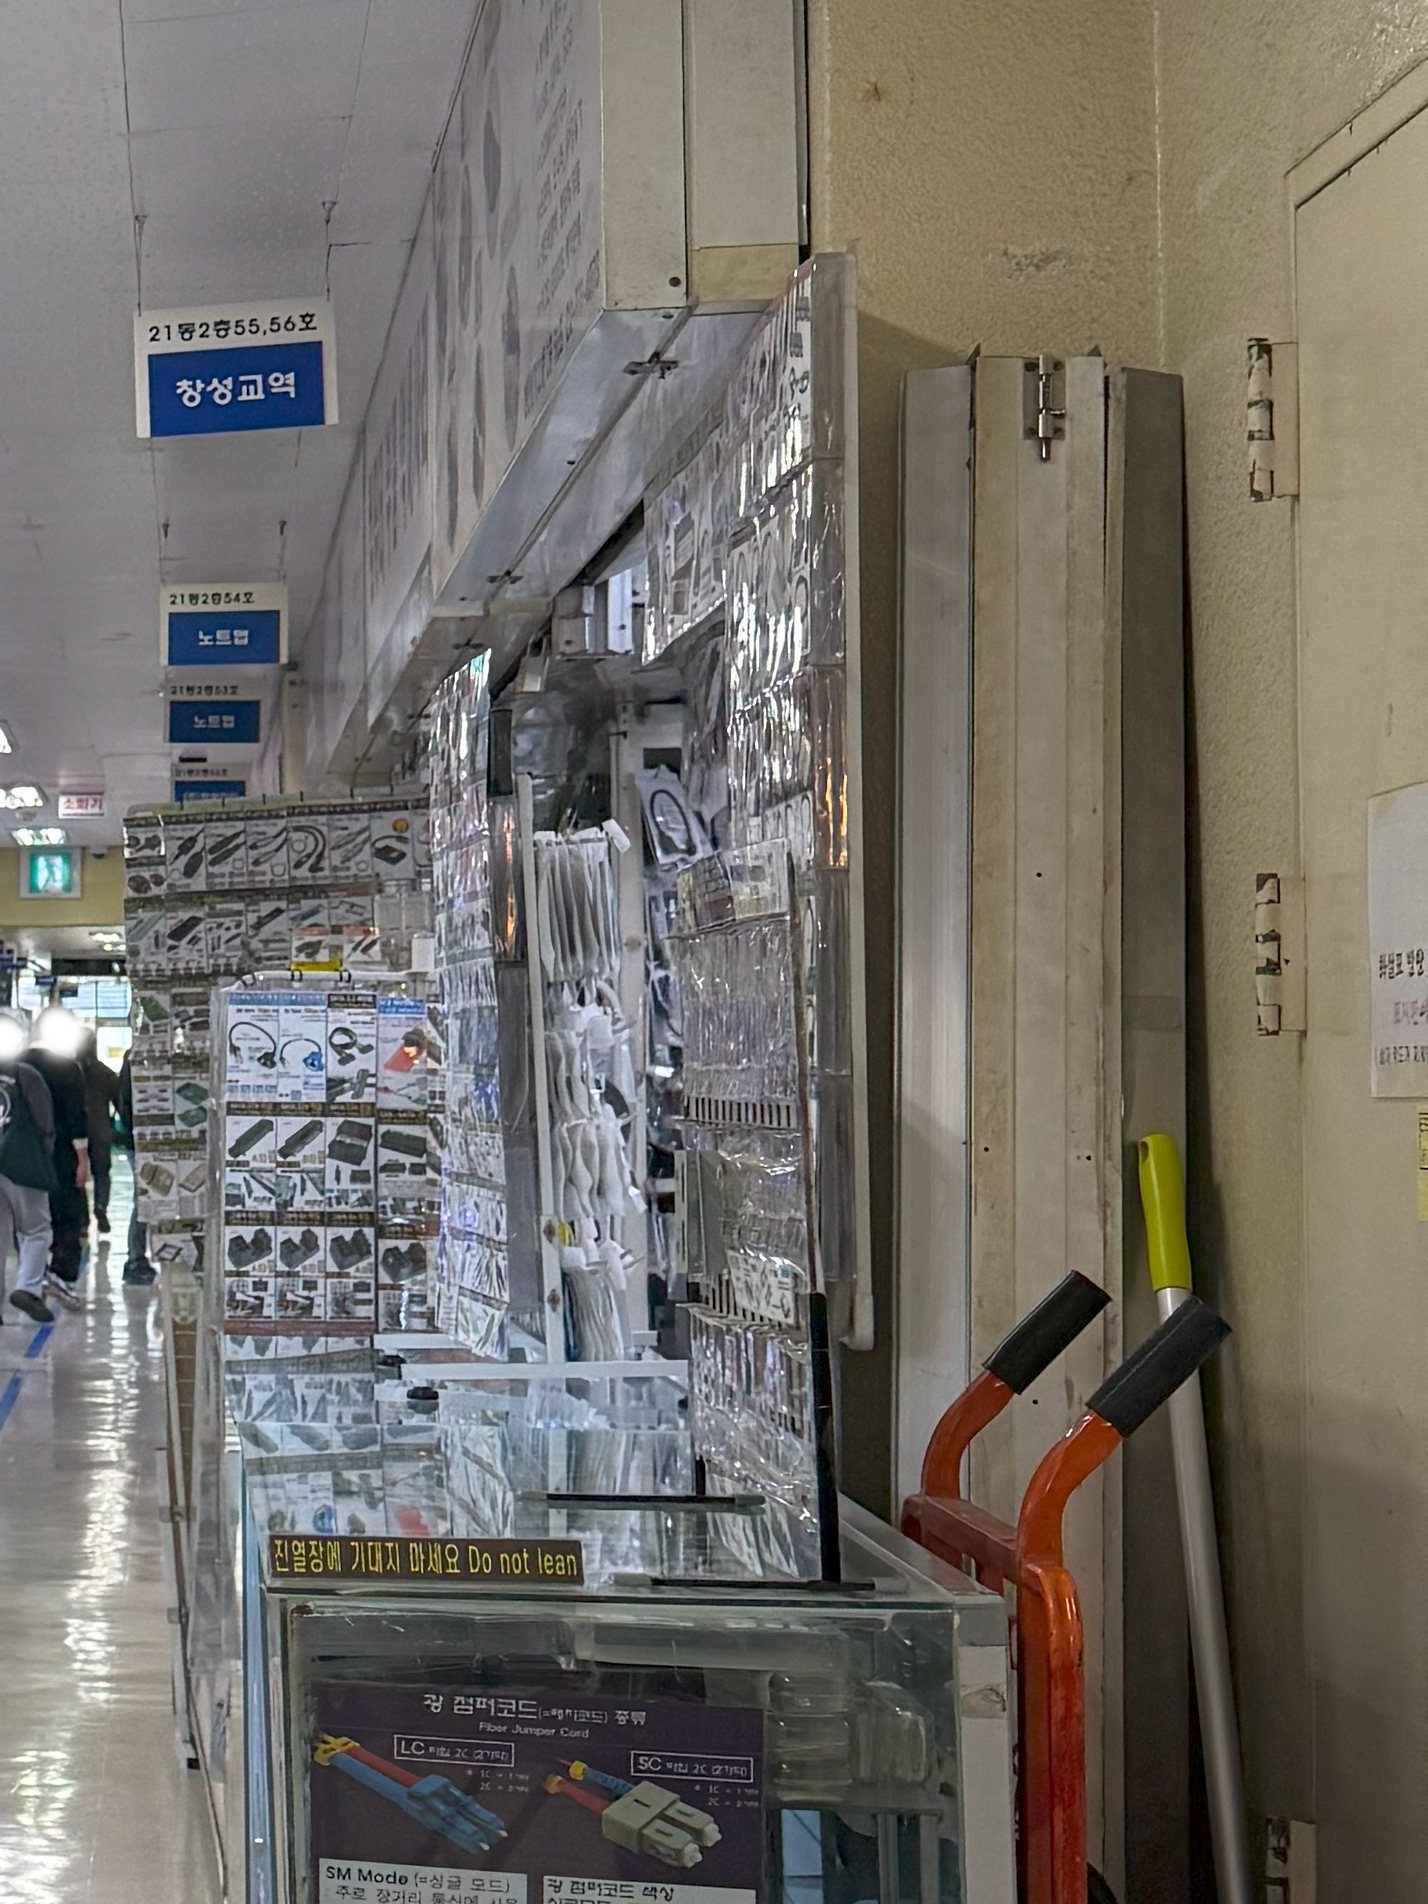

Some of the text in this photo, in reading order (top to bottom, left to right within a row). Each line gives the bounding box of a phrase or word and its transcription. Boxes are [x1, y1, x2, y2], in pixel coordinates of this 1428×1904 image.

[148, 309, 319, 343] 21동2층55,56호
[174, 370, 298, 408] 창성교역
[62, 796, 104, 812] 소화기
[274, 1539, 578, 1576] 진열장에 기대지 마세요 Do not lean
[512, 1724, 556, 1738] Jumper
[560, 1726, 590, 1739] Cord
[400, 1740, 425, 1756] LC
[637, 1756, 662, 1772] SC
[325, 1865, 352, 1881] SM
[358, 1868, 409, 1886] Mode
